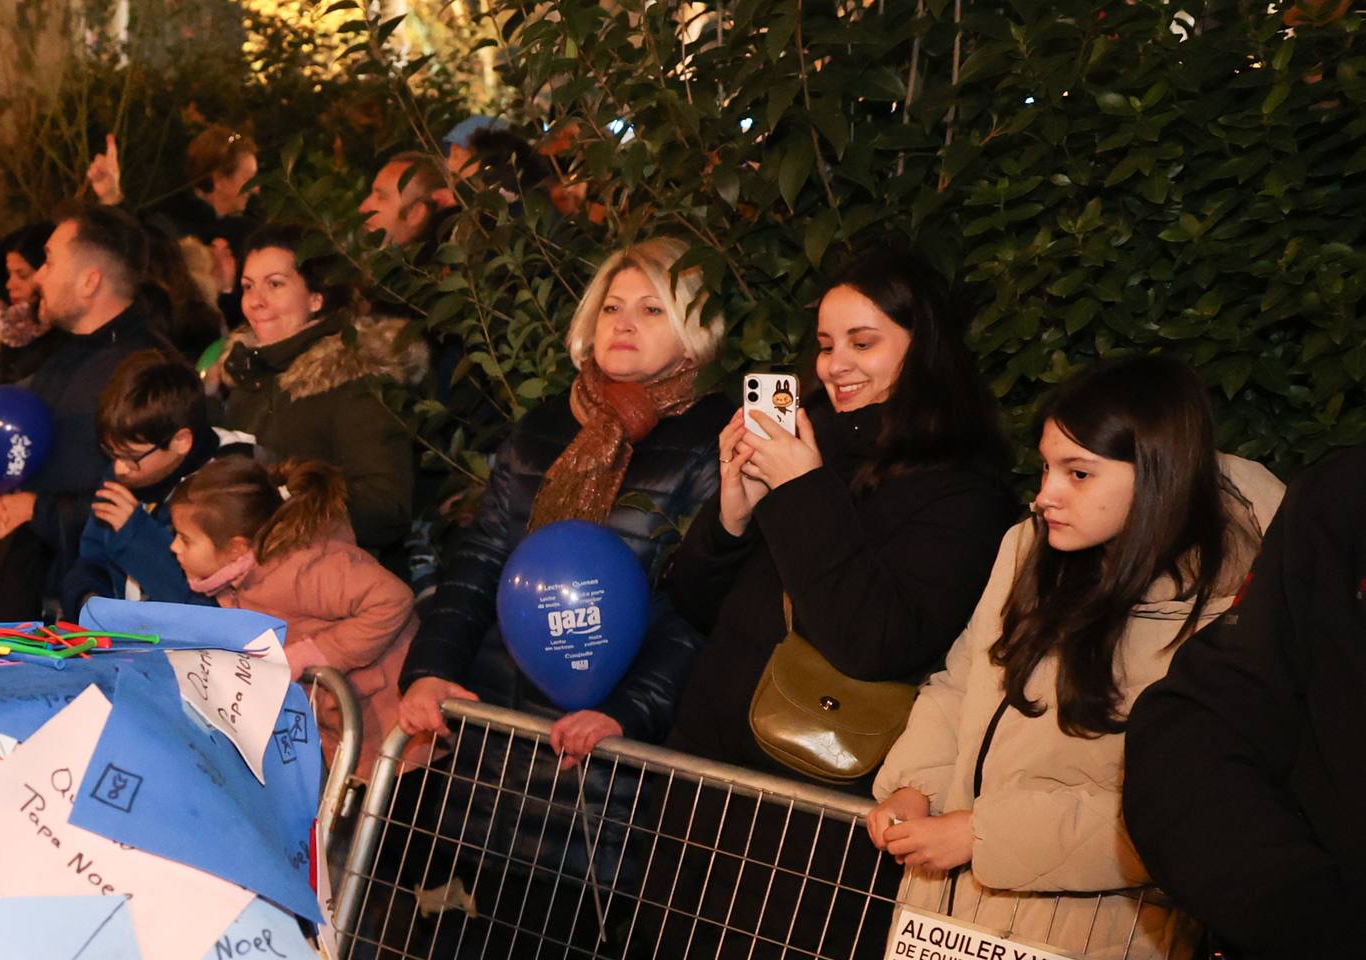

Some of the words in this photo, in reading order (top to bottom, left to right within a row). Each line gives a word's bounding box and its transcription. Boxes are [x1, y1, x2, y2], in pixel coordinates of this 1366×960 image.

[548, 606, 601, 636] gaza
[218, 692, 243, 733] Papa
[20, 783, 61, 848] Papa
[895, 941, 916, 958] DE
